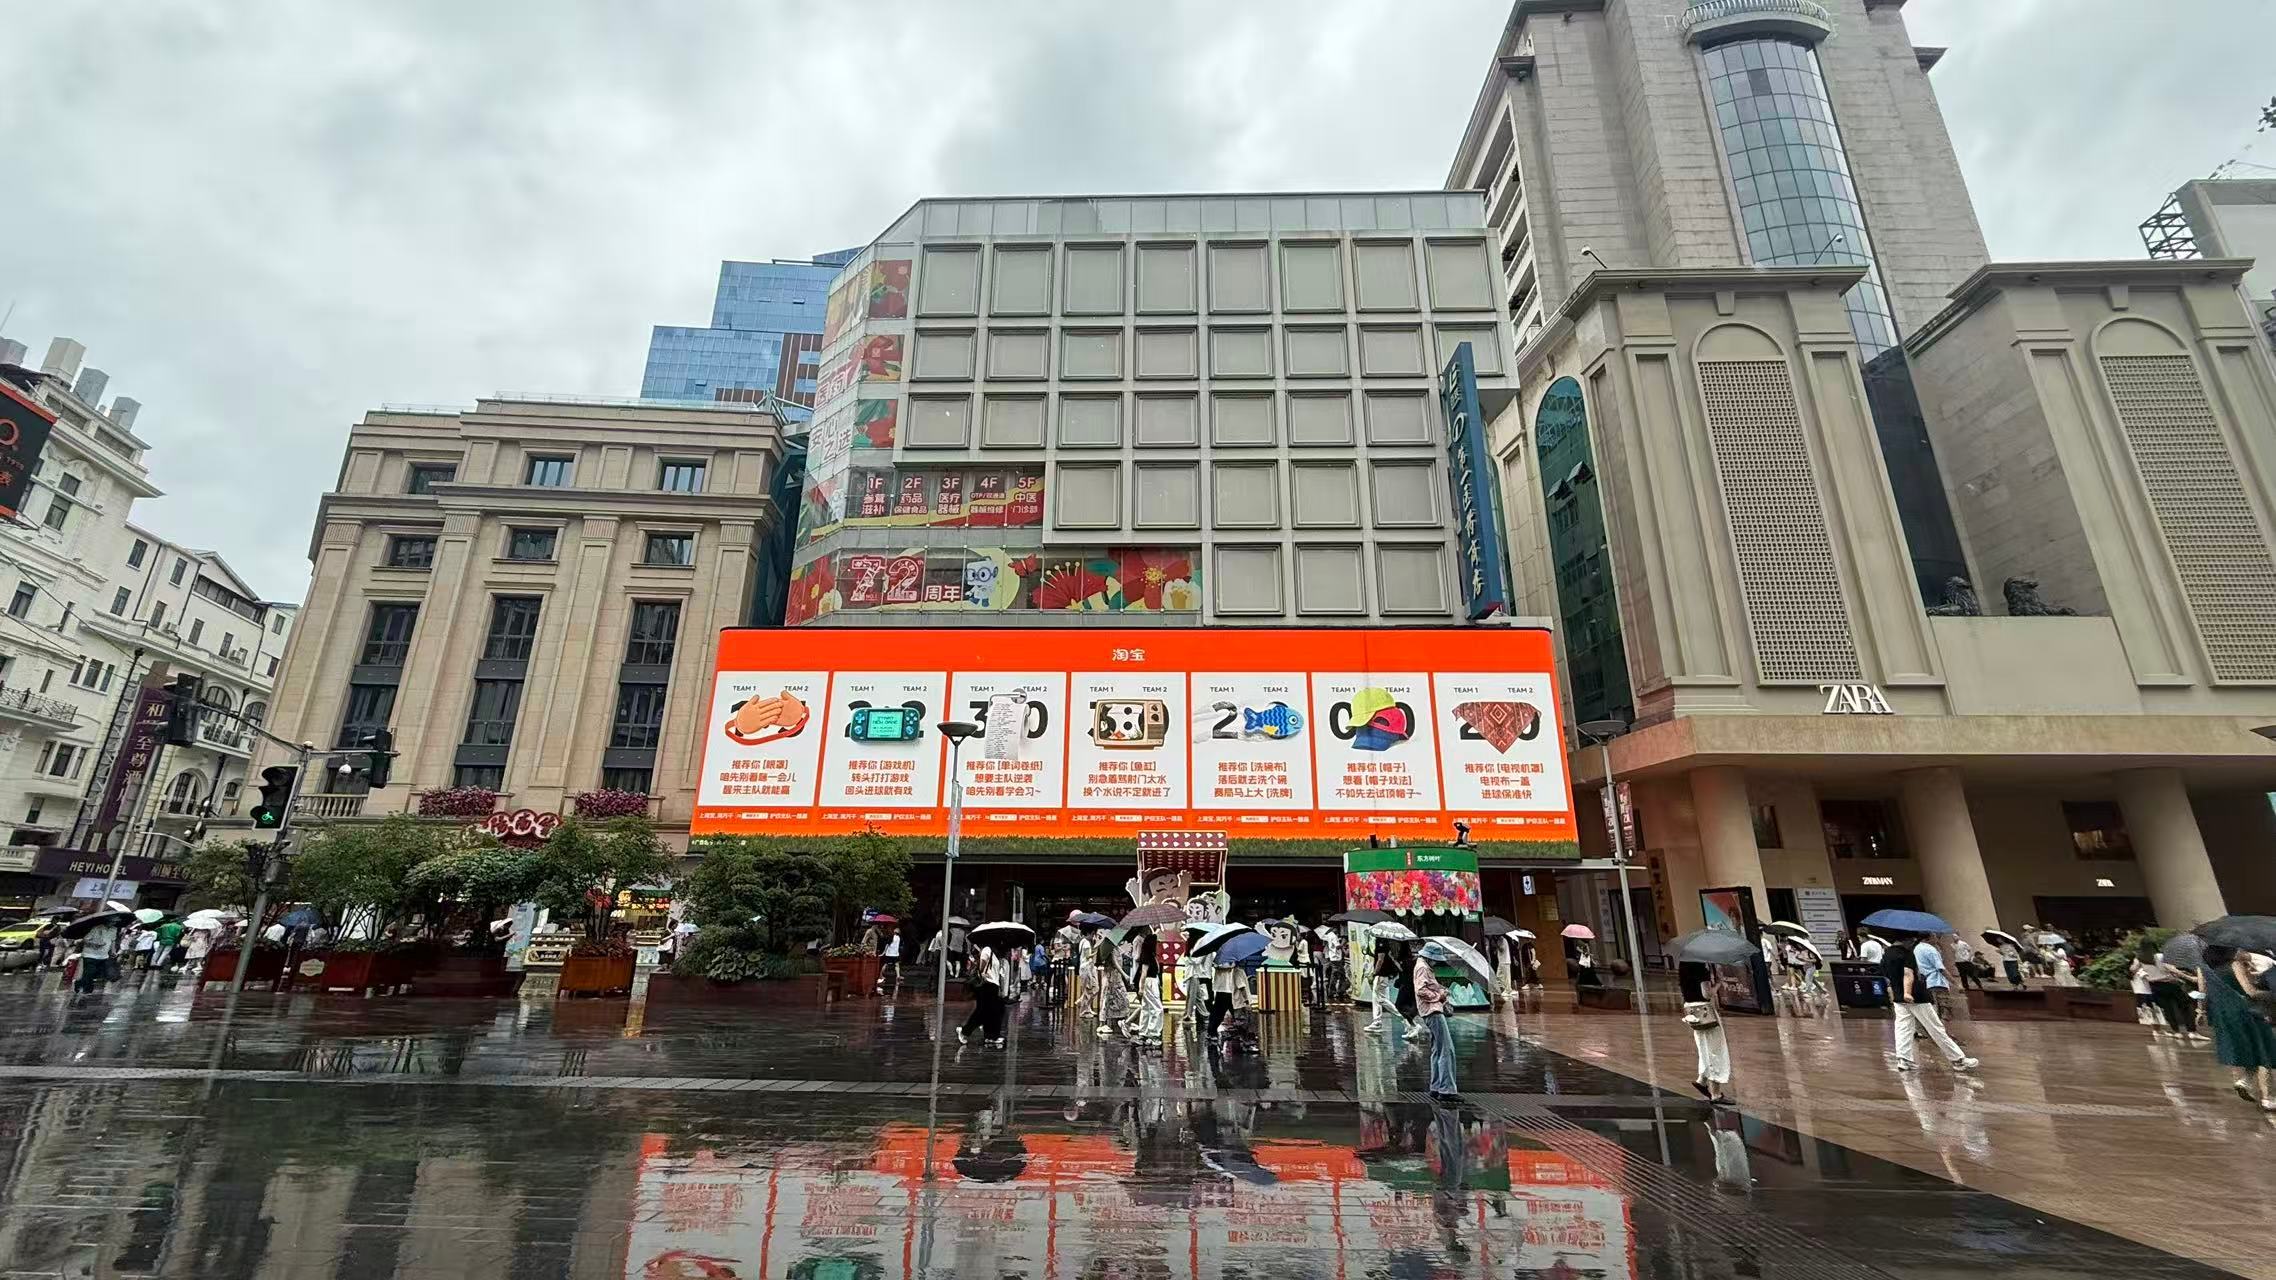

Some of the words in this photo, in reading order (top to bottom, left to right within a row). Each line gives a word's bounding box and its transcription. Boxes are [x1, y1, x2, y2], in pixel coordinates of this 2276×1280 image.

[869, 477, 884, 490] 1F
[904, 477, 922, 489] 2F
[942, 477, 960, 489] 3F
[980, 477, 998, 489] 4F
[1018, 476, 1036, 488] 5F
[900, 492, 923, 504] 药品
[938, 492, 961, 504] 医疗
[1015, 492, 1037, 503] 中医
[937, 504, 960, 514] 器械
[1012, 506, 1038, 514] 门诊部
[851, 558, 918, 601] 72
[924, 584, 961, 602] 周年
[1111, 648, 1146, 662] 淘宝
[1819, 683, 1895, 715] ZARA
[1212, 701, 1239, 739] 2
[69, 861, 96, 873] HEYI
[95, 863, 128, 876] HOEL
